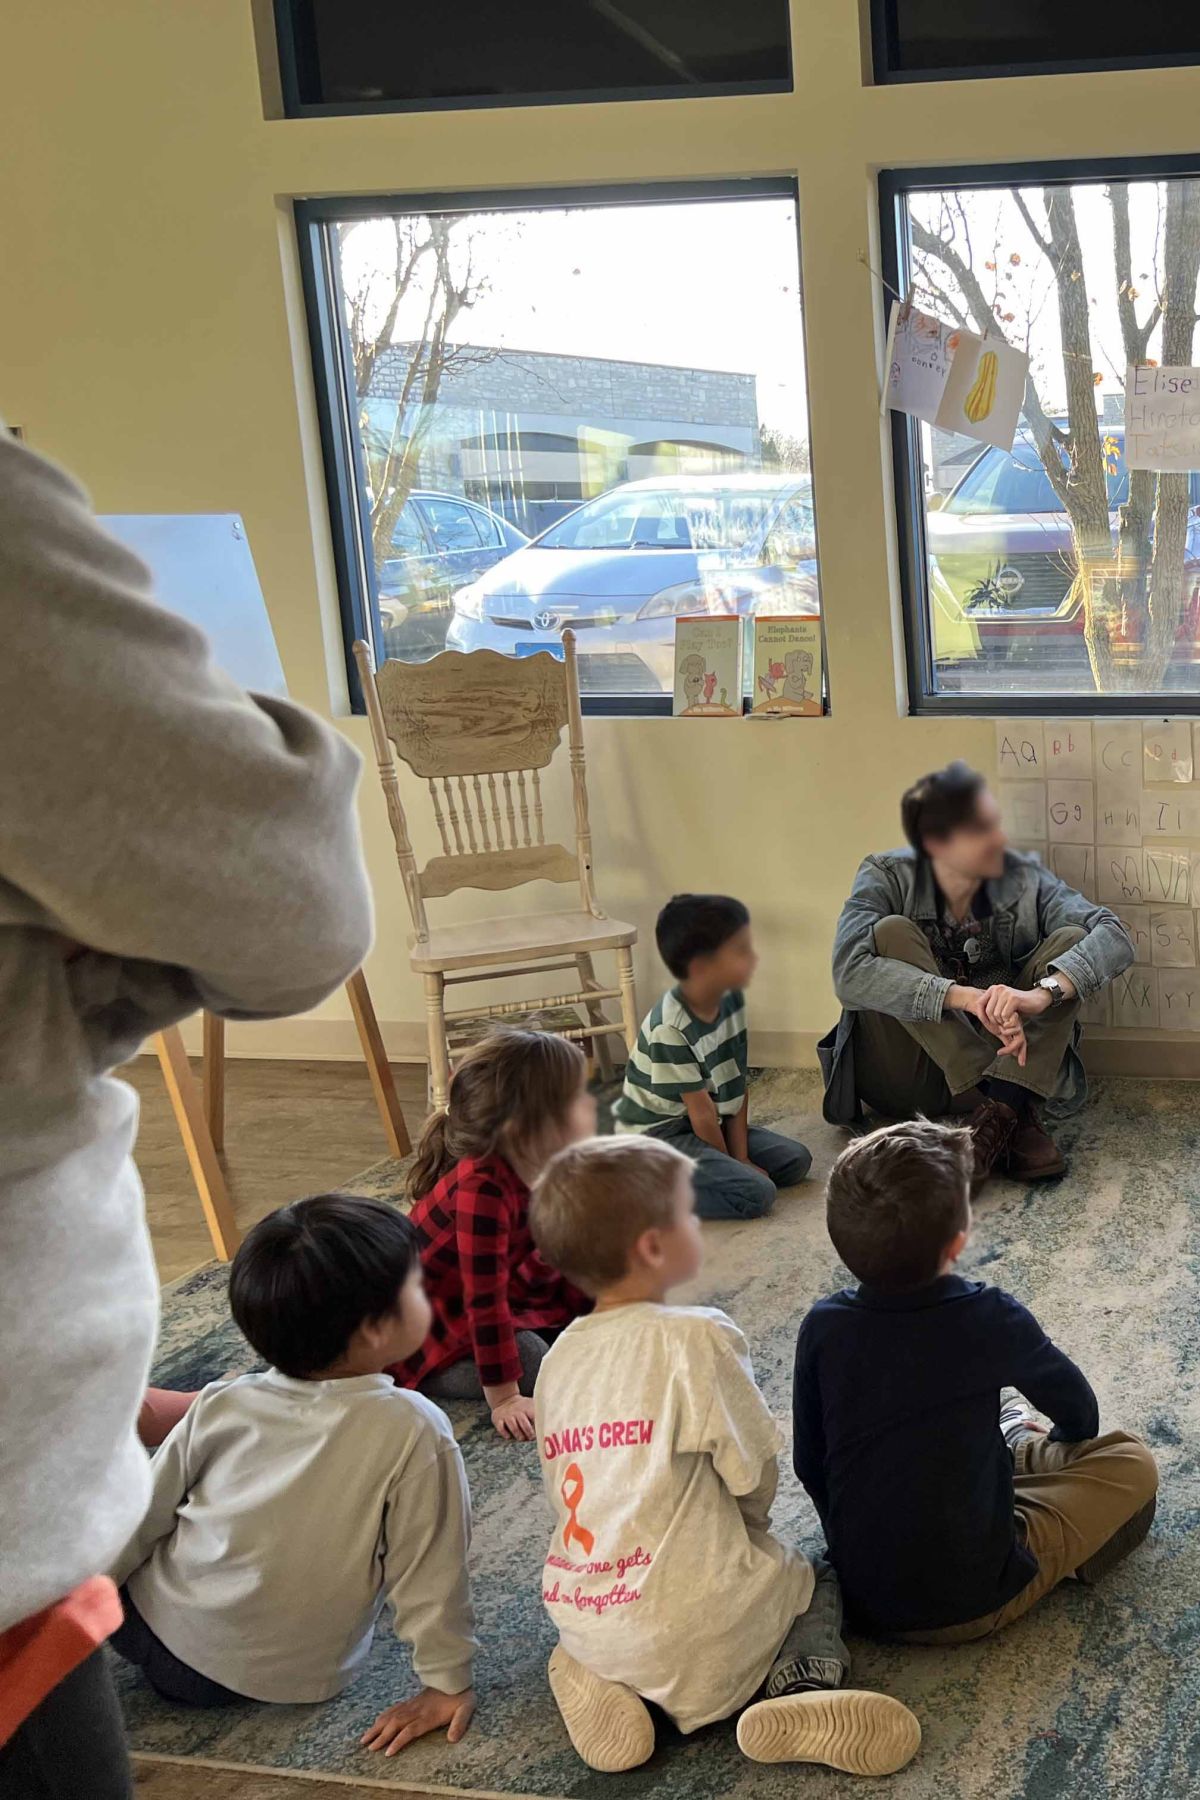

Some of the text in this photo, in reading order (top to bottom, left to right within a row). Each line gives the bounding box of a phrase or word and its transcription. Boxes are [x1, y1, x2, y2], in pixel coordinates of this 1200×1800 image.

[1134, 366, 1192, 395] Elise
[758, 634, 816, 643] Cannot Dance!
[768, 625, 807, 635] Elephants
[599, 1420, 655, 1449] CREW
[616, 1546, 652, 1578] gets
[574, 1583, 641, 1615] forgotten
